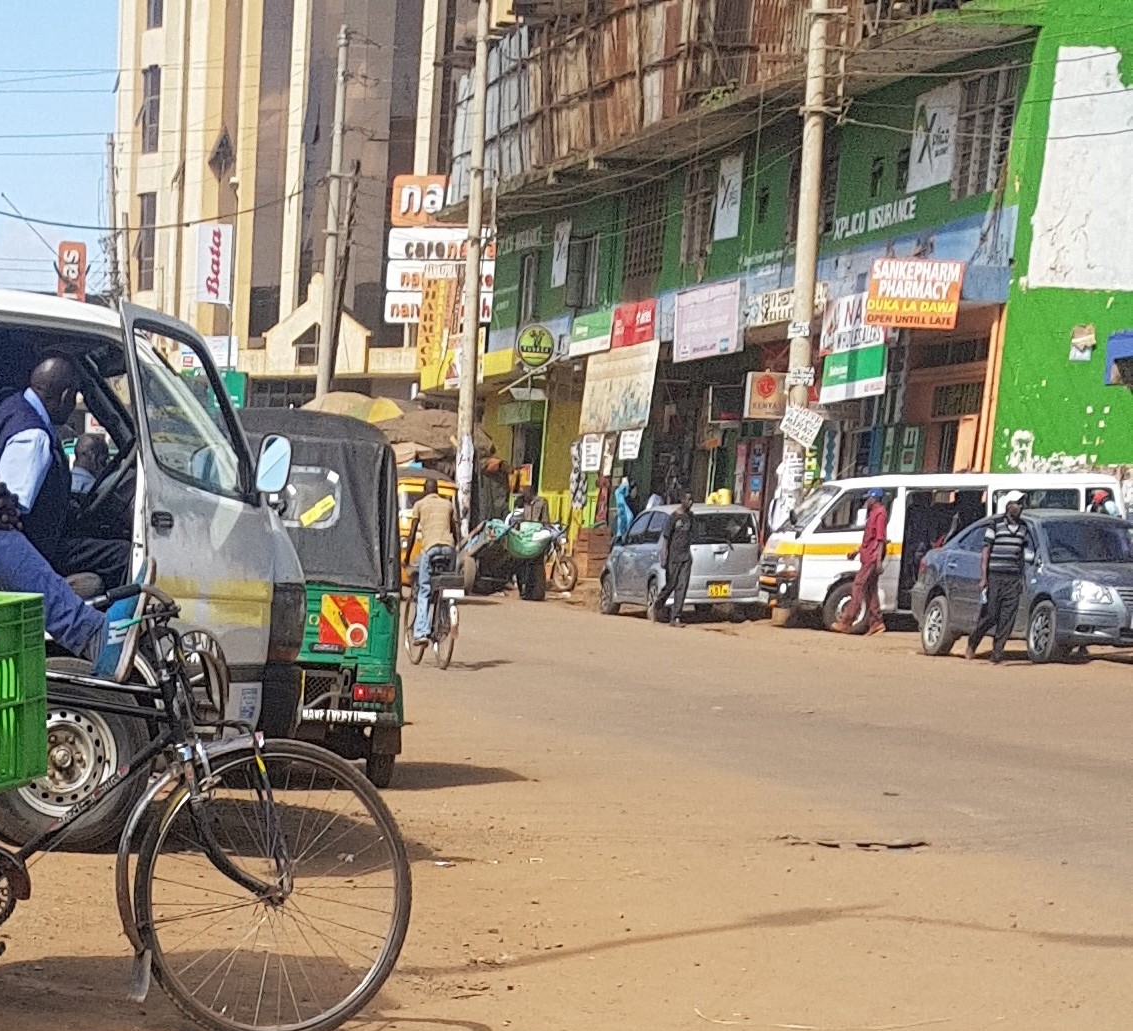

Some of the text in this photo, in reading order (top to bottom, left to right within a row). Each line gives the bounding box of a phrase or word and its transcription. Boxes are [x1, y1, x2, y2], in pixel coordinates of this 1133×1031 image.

[833, 195, 917, 241] XPLICO INSURANCE
[206, 227, 223, 300] Bata
[872, 260, 961, 283] SANKEPHARM
[878, 280, 951, 300] PHARMACY
[867, 299, 957, 313] DUKA LA DAWA
[867, 314, 953, 325] OPEN UNTILL LATE
